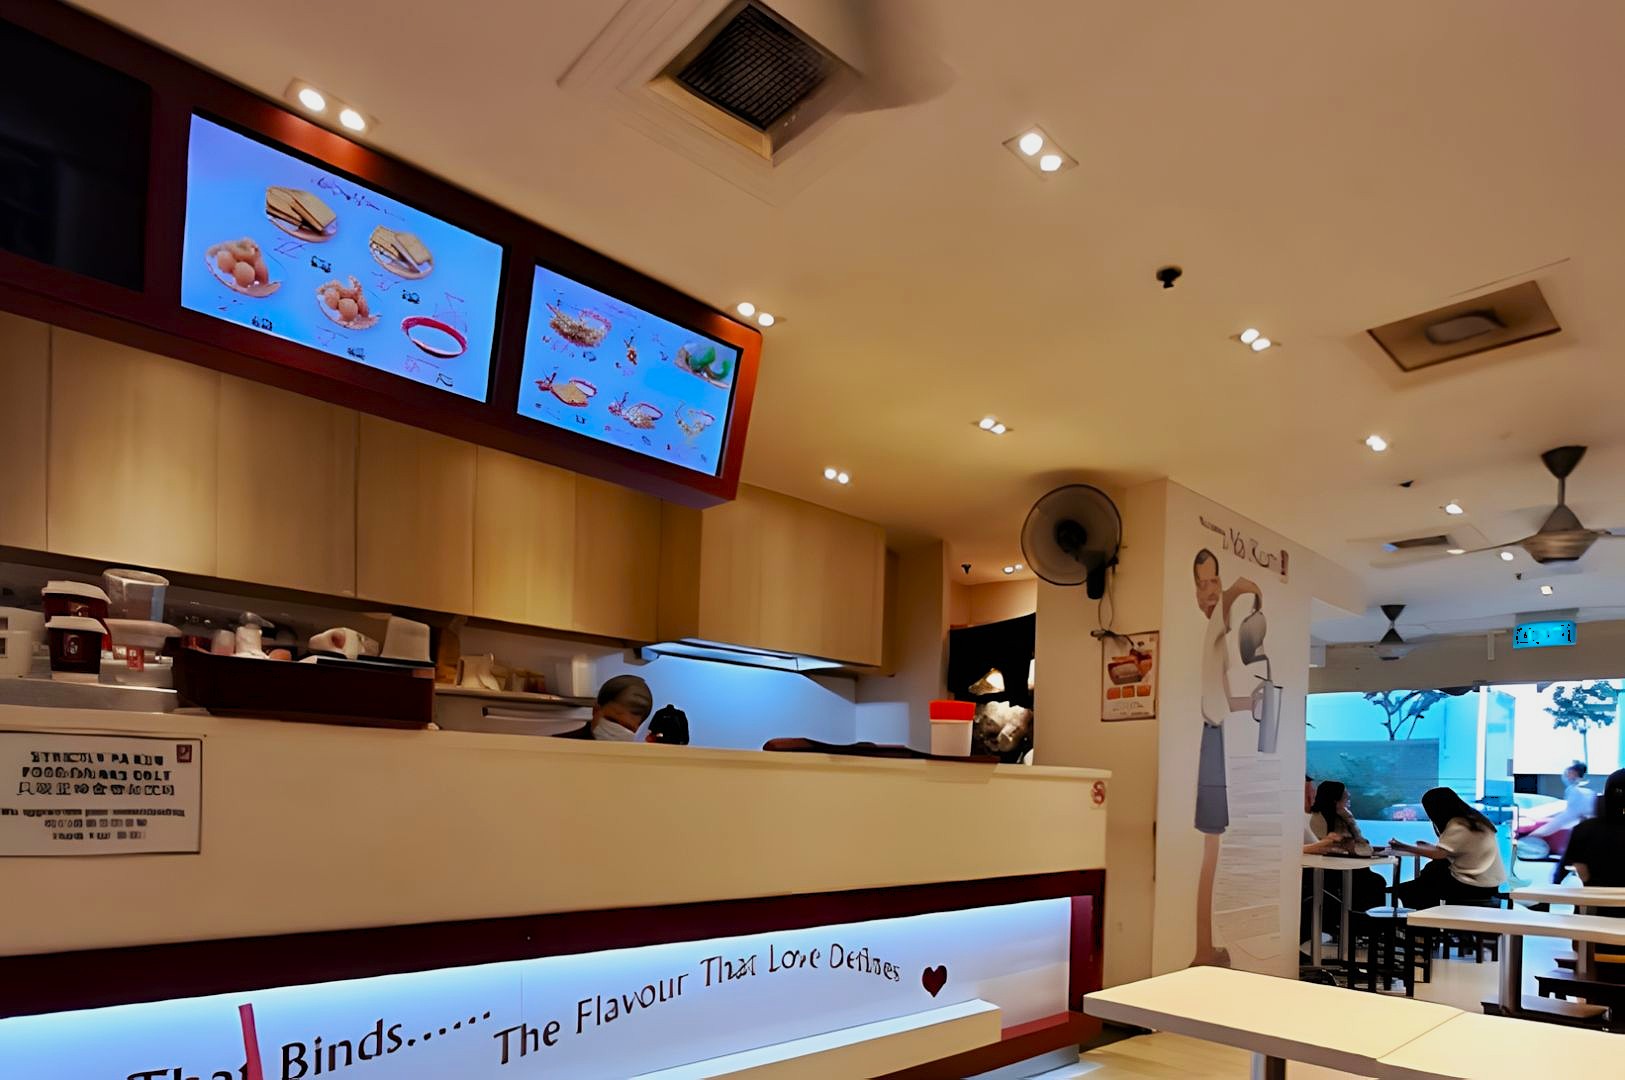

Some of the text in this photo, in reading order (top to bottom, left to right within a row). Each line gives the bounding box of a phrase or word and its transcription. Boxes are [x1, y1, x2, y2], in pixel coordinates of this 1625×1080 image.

[494, 1019, 561, 1065] The
[576, 973, 689, 1034] Flavour
[769, 943, 821, 974] Love
